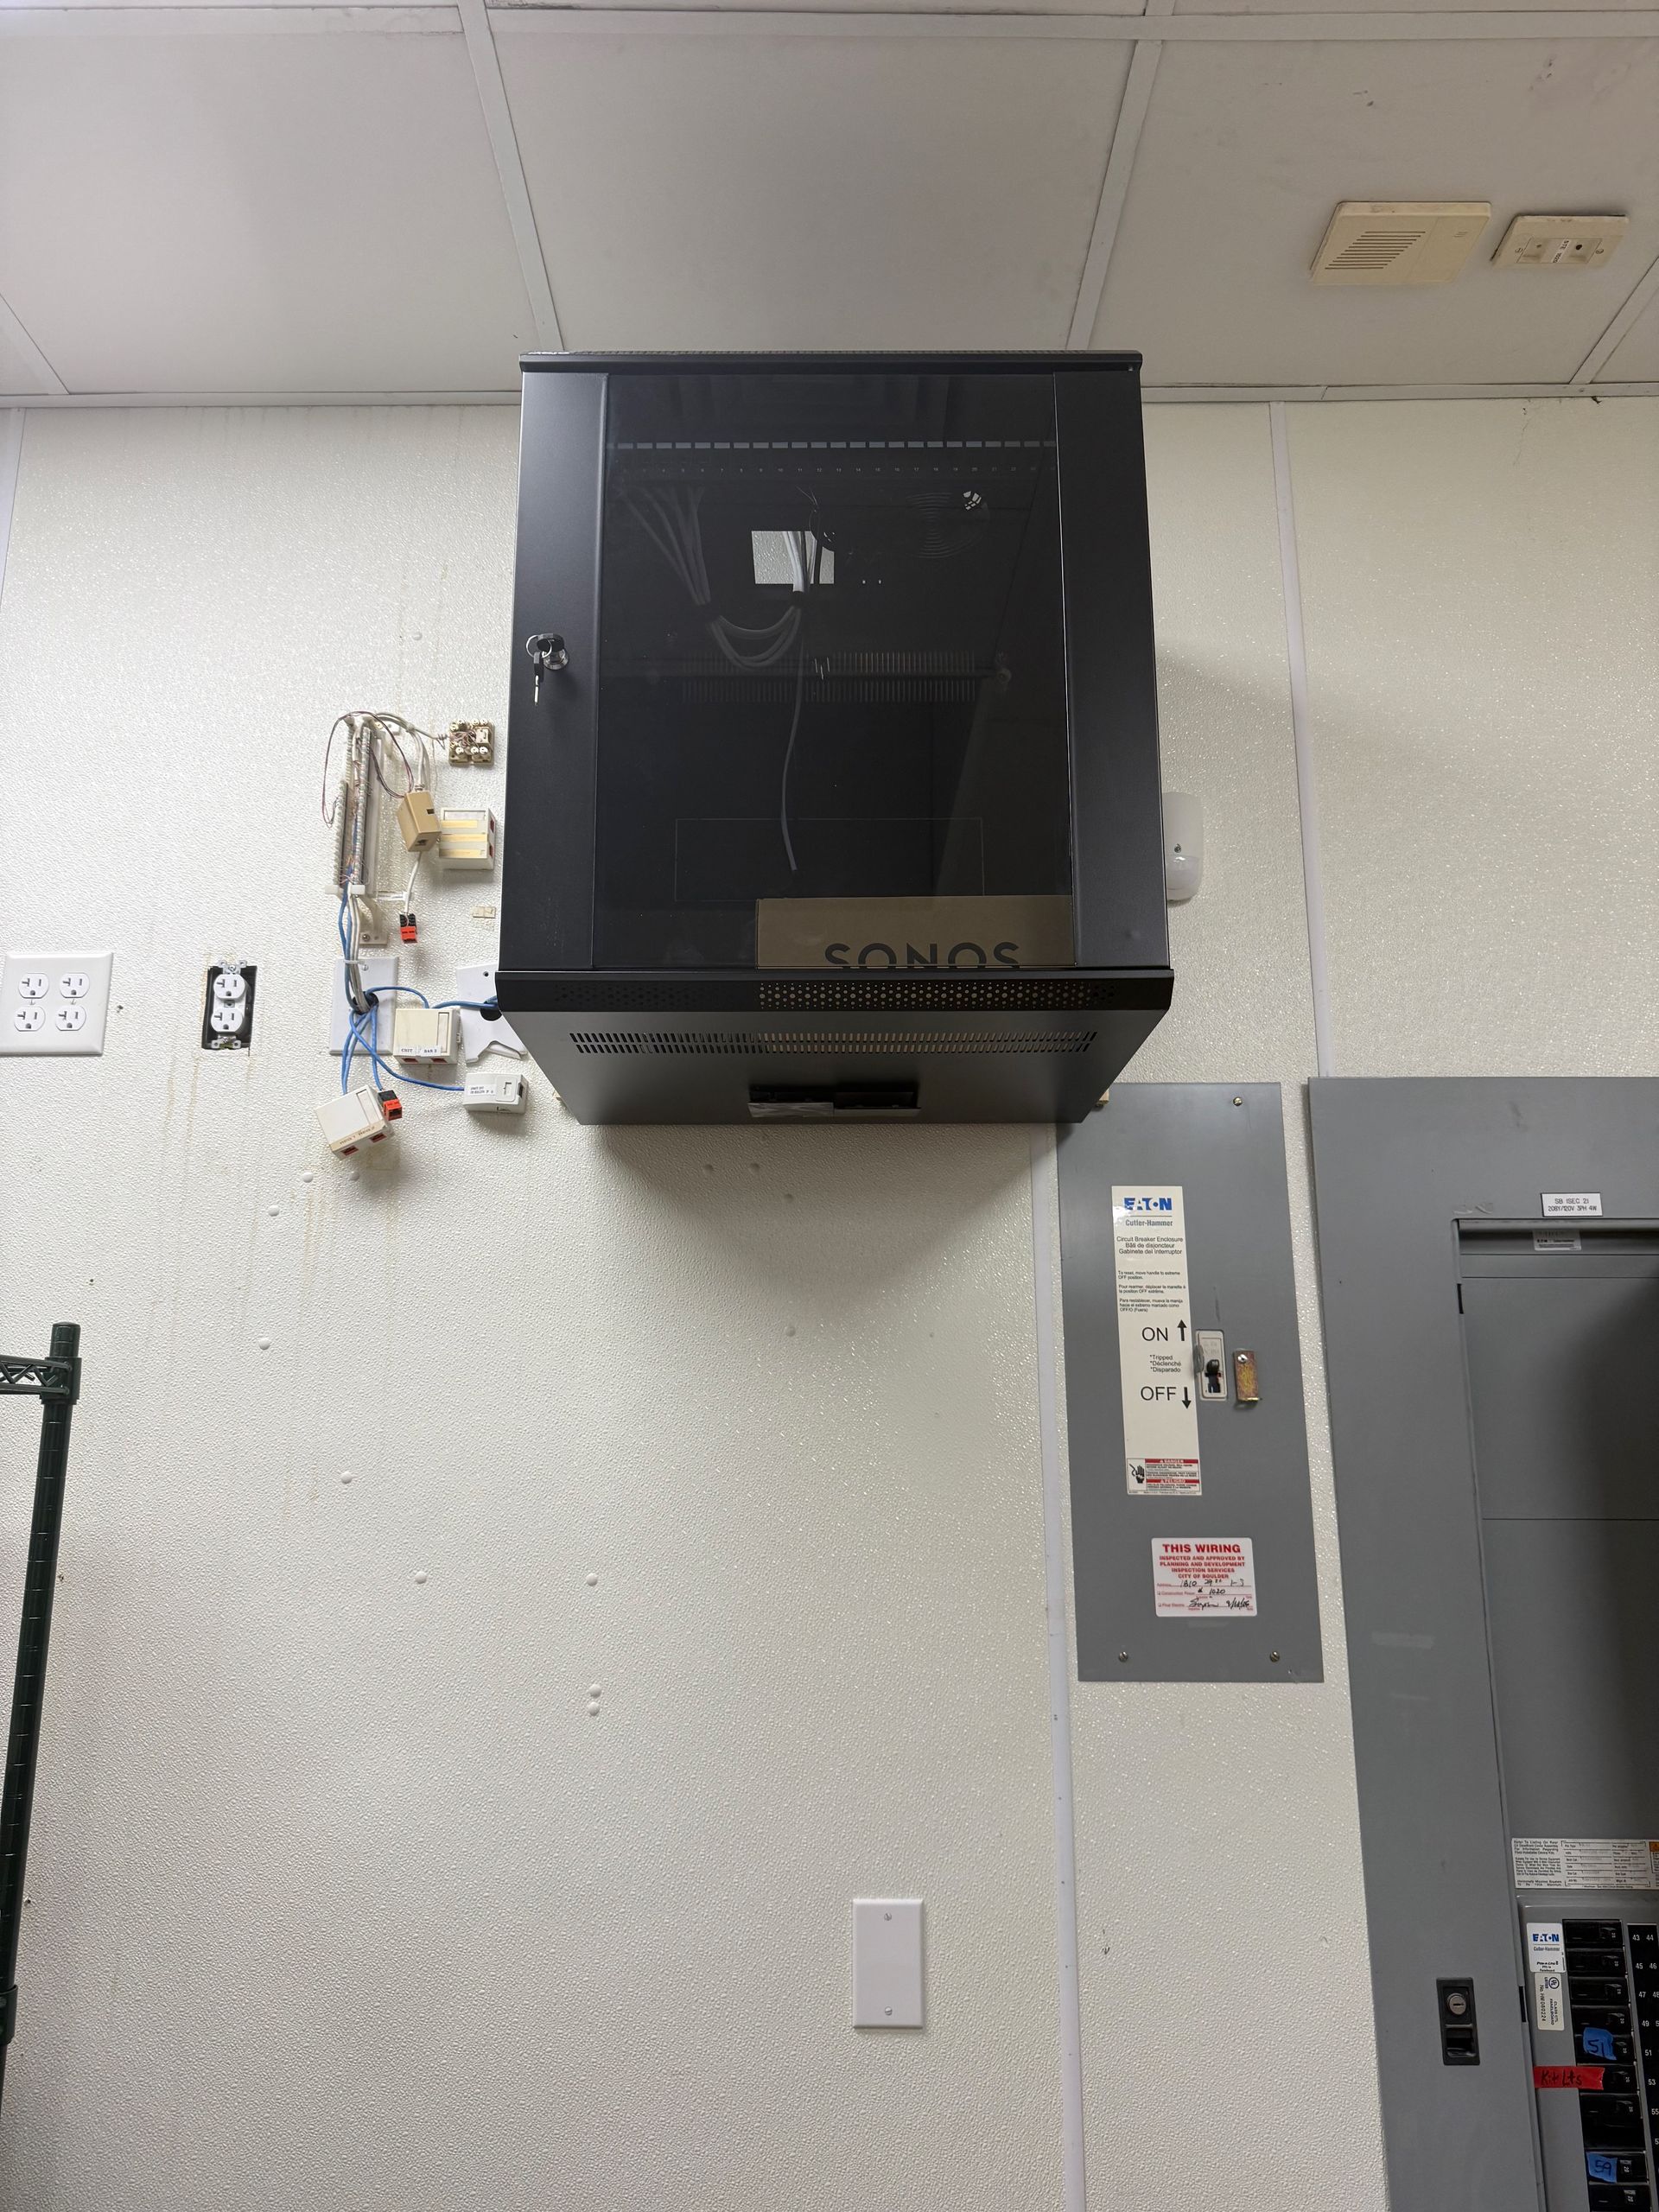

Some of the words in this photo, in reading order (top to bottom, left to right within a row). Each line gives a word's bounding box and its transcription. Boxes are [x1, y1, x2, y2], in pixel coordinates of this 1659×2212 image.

[825, 942, 1020, 968] SONOS
[1123, 1198, 1173, 1211] EATON
[1141, 1327, 1168, 1342] ON
[1141, 1386, 1177, 1401] OFF
[1162, 1544, 1191, 1553] THIS
[1195, 1544, 1241, 1553] WIRING
[1588, 2039, 1605, 2056] 51
[1594, 2160, 1611, 2176] 59
